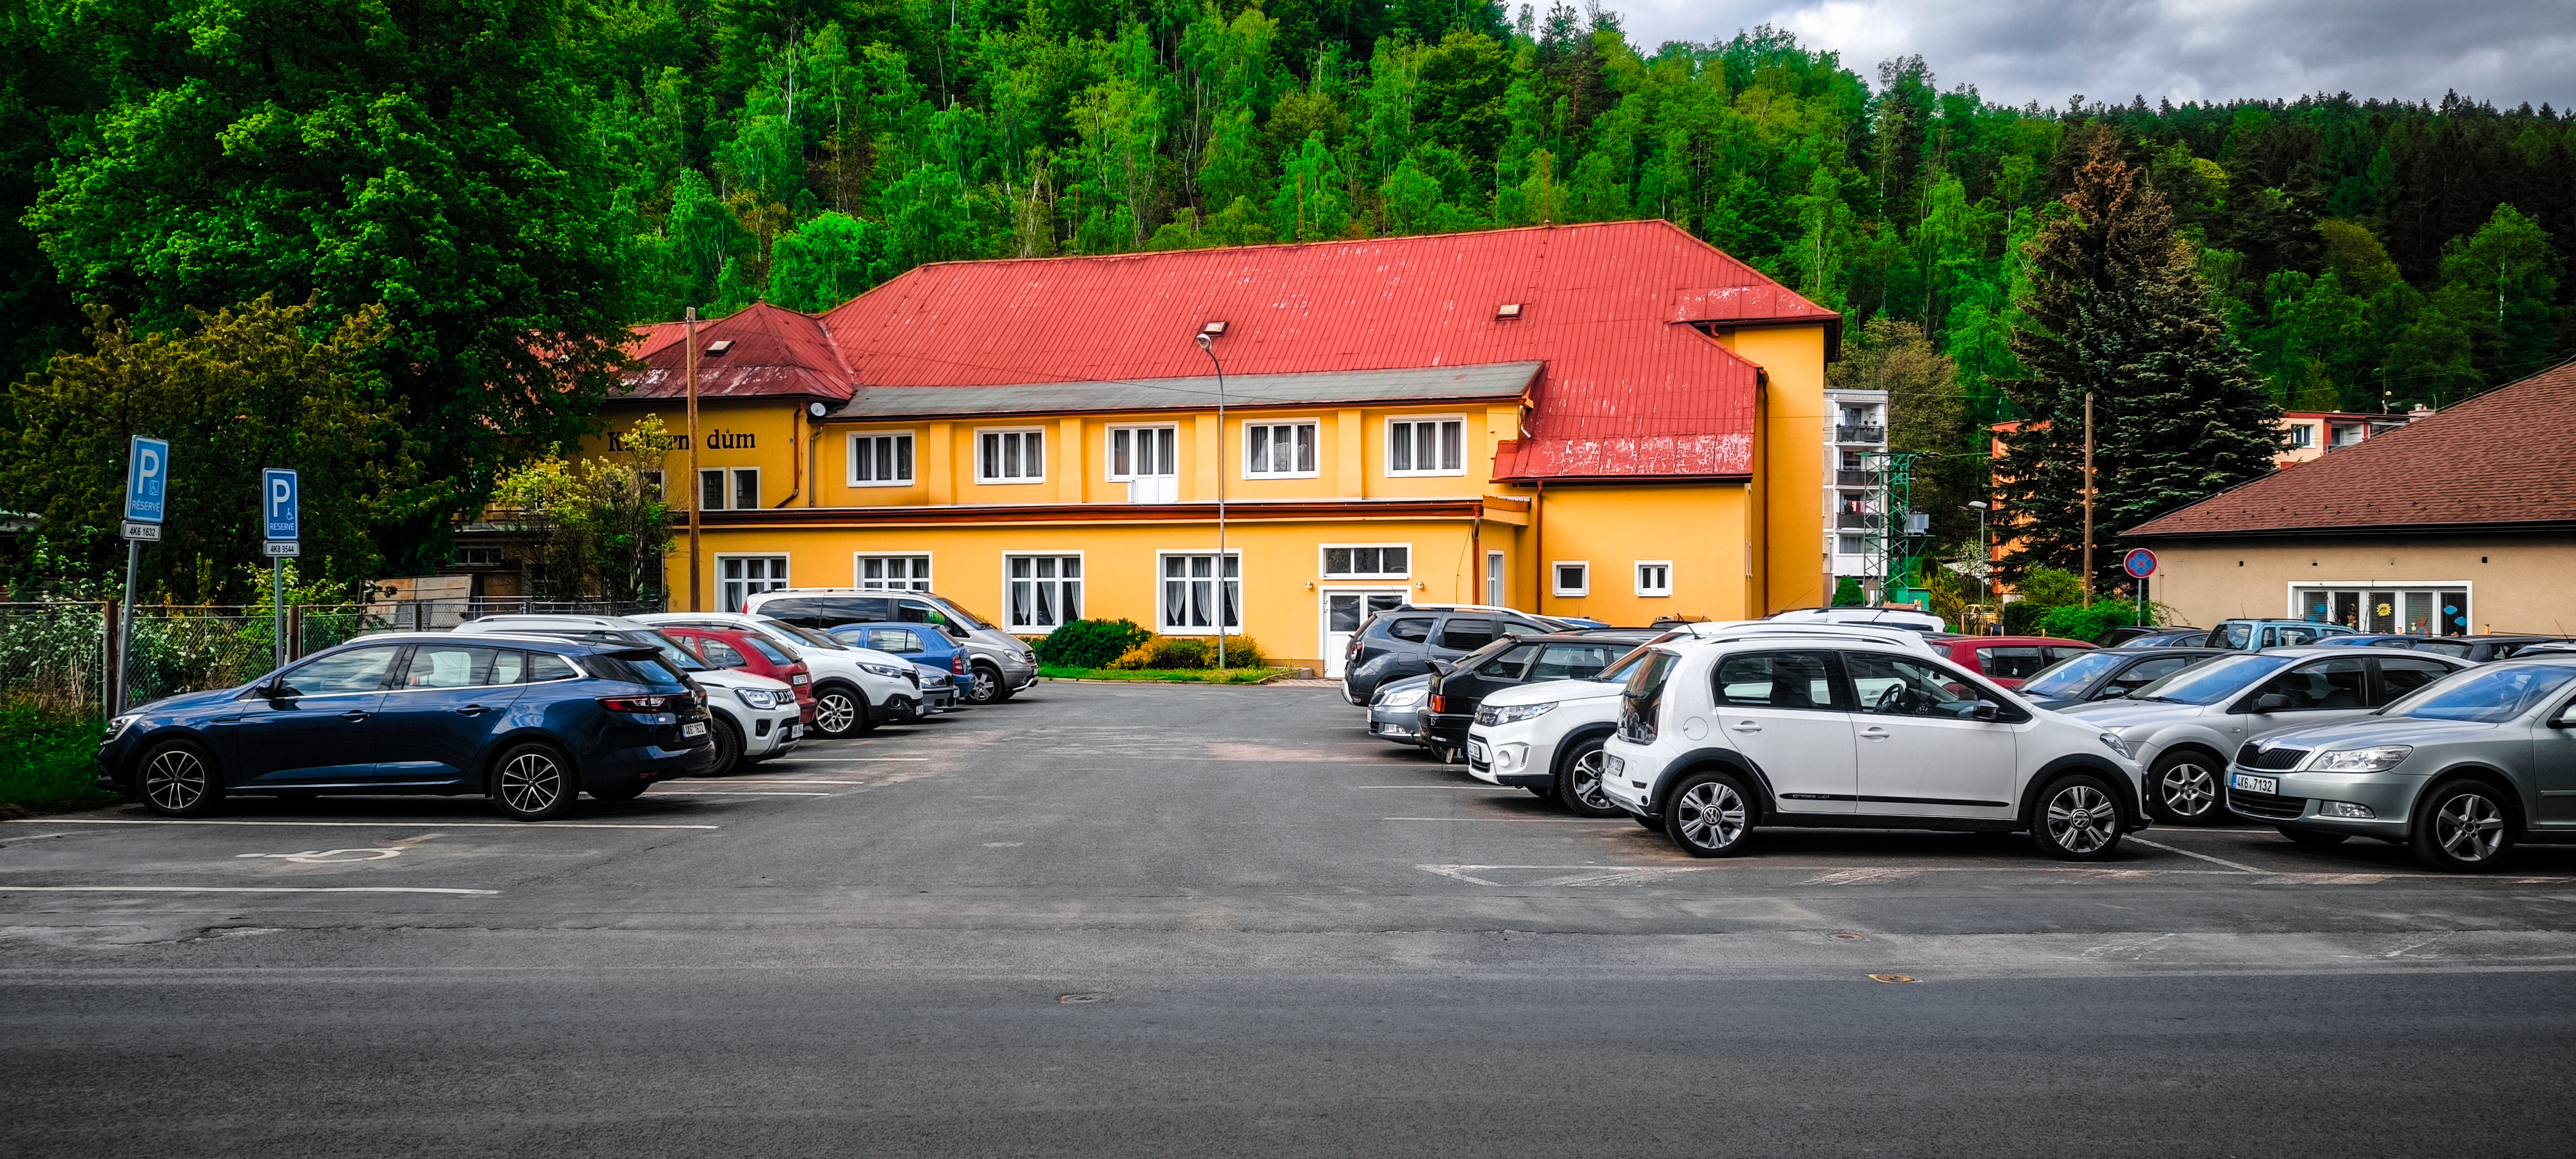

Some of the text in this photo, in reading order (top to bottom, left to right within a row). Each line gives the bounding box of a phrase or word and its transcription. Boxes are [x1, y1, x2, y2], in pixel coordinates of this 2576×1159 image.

[707, 429, 755, 449] dům
[138, 449, 159, 494] P
[132, 499, 160, 512] RÉSERVÉ
[272, 479, 290, 517] P
[129, 527, 155, 536] 4K6 1632
[270, 522, 294, 531] RÉSERVÉ
